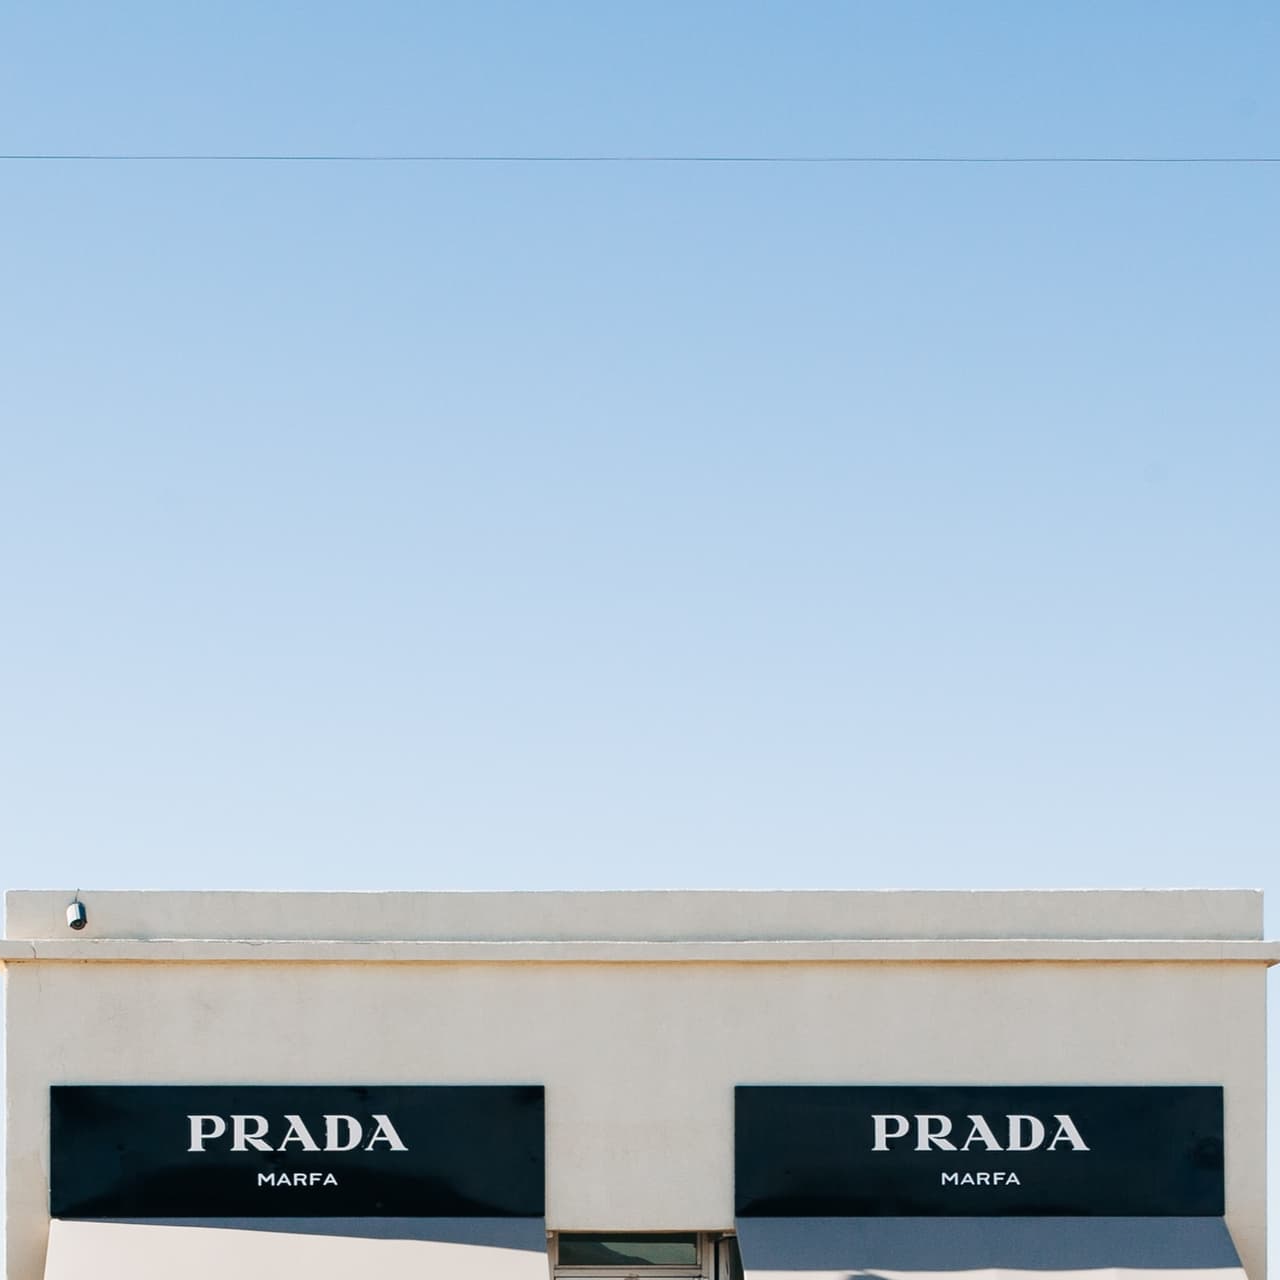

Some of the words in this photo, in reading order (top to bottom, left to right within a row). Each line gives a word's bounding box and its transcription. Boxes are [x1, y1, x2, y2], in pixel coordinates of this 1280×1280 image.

[187, 1115, 408, 1151] PRADA
[872, 1115, 1090, 1151] PRADA
[258, 1173, 338, 1186] MARFA
[942, 1172, 1021, 1185] MARFA
